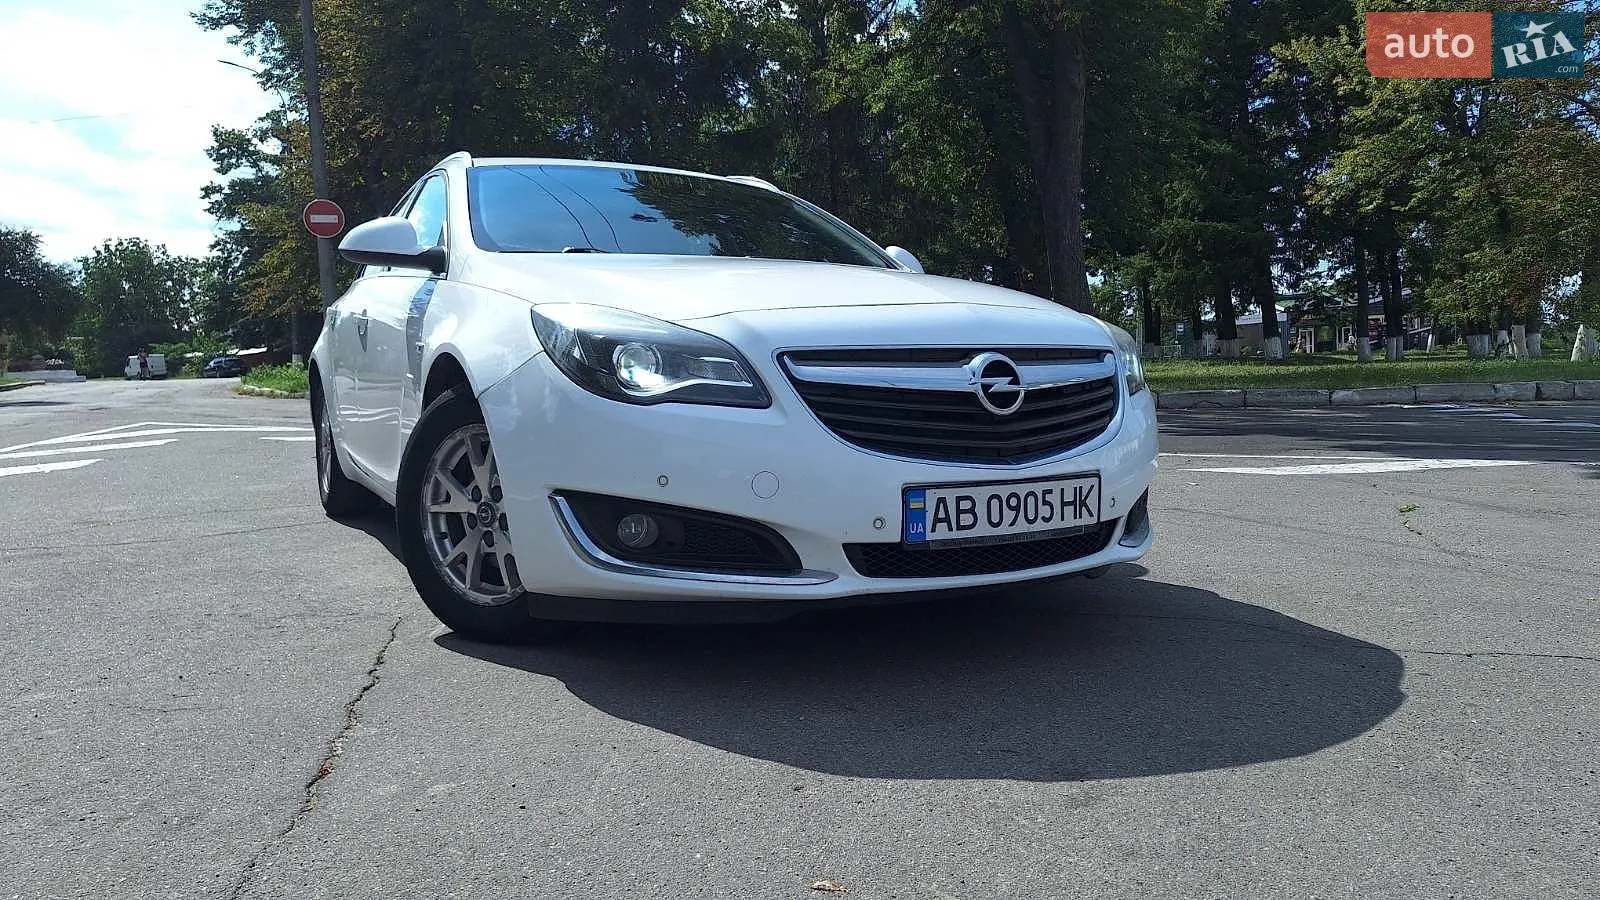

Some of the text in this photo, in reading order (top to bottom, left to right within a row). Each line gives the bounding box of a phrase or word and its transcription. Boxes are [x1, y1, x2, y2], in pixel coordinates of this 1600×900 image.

[930, 484, 1095, 533] AB 0905 HK
[909, 523, 925, 534] UA
